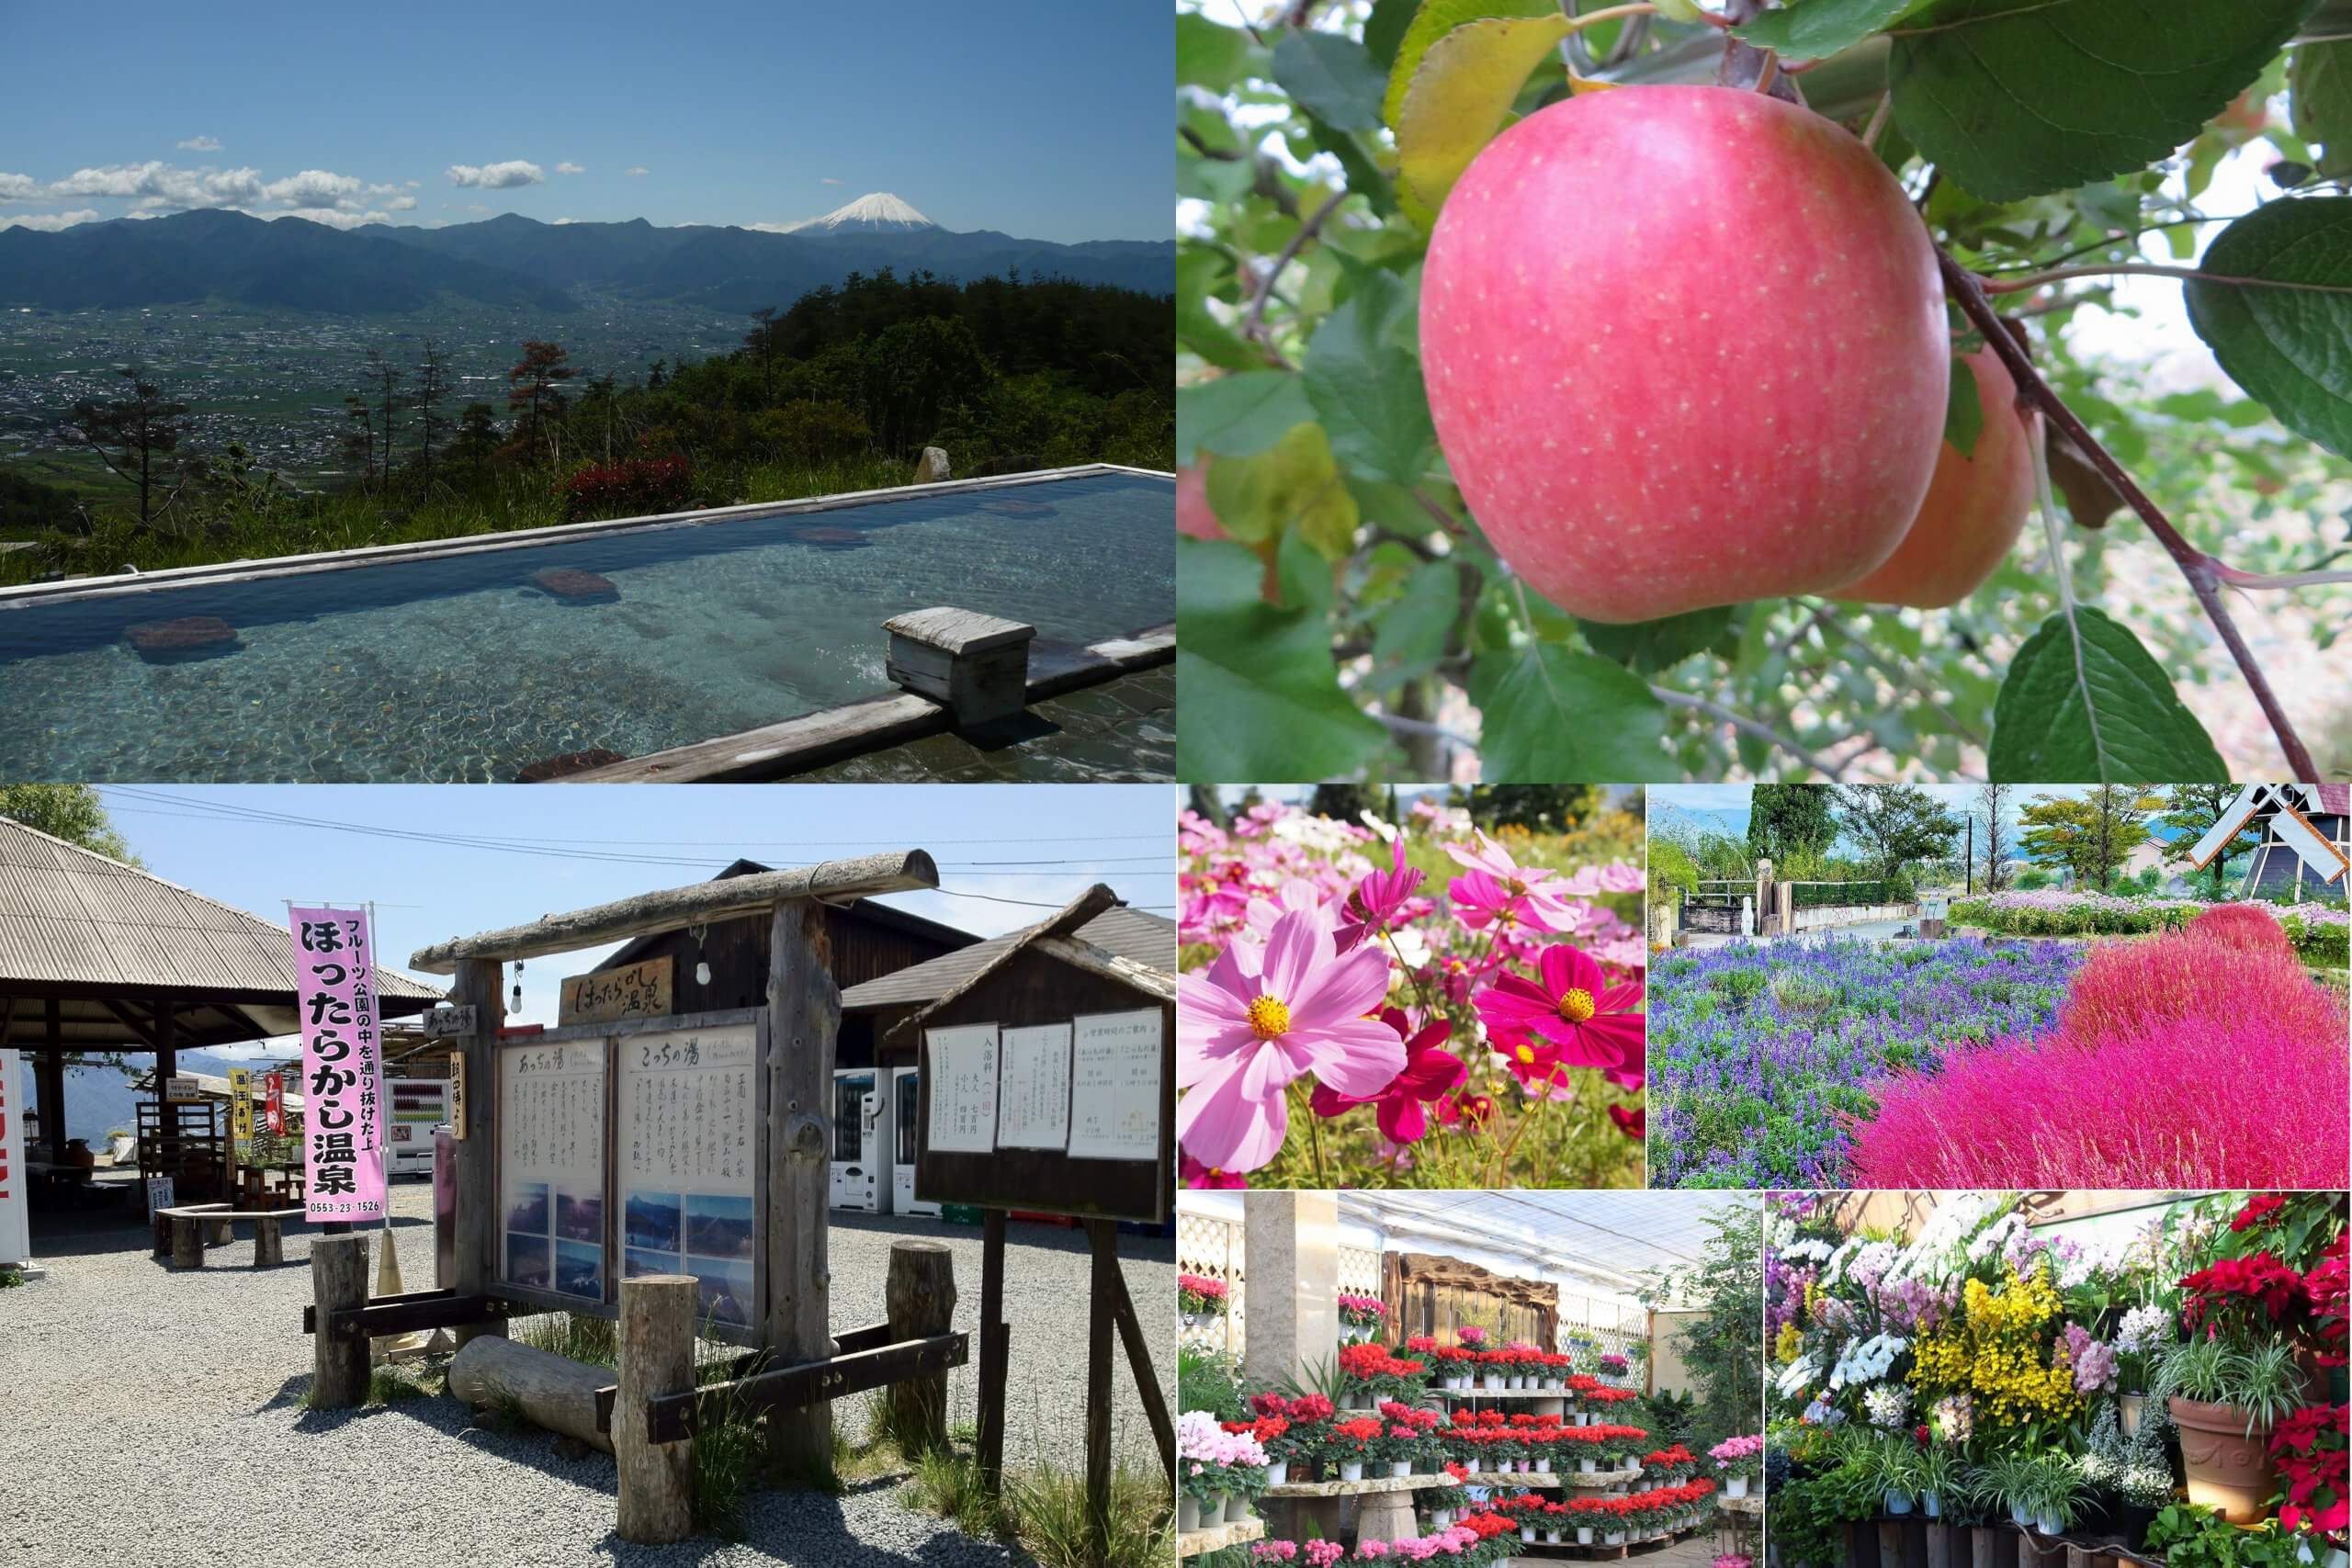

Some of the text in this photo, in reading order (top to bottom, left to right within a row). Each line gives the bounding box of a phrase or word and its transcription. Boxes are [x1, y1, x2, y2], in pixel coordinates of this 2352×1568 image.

[621, 984, 662, 1015] 温泉
[428, 1008, 473, 1030] あっちの湯
[345, 919, 374, 1151] フルーツ公園の中を通り抜けた上
[300, 920, 357, 1194] ほったらかし温泉
[519, 1047, 565, 1074] あっちの湯
[641, 1036, 699, 1066] こっちの湯
[310, 1200, 379, 1213] 0553-23-1526
